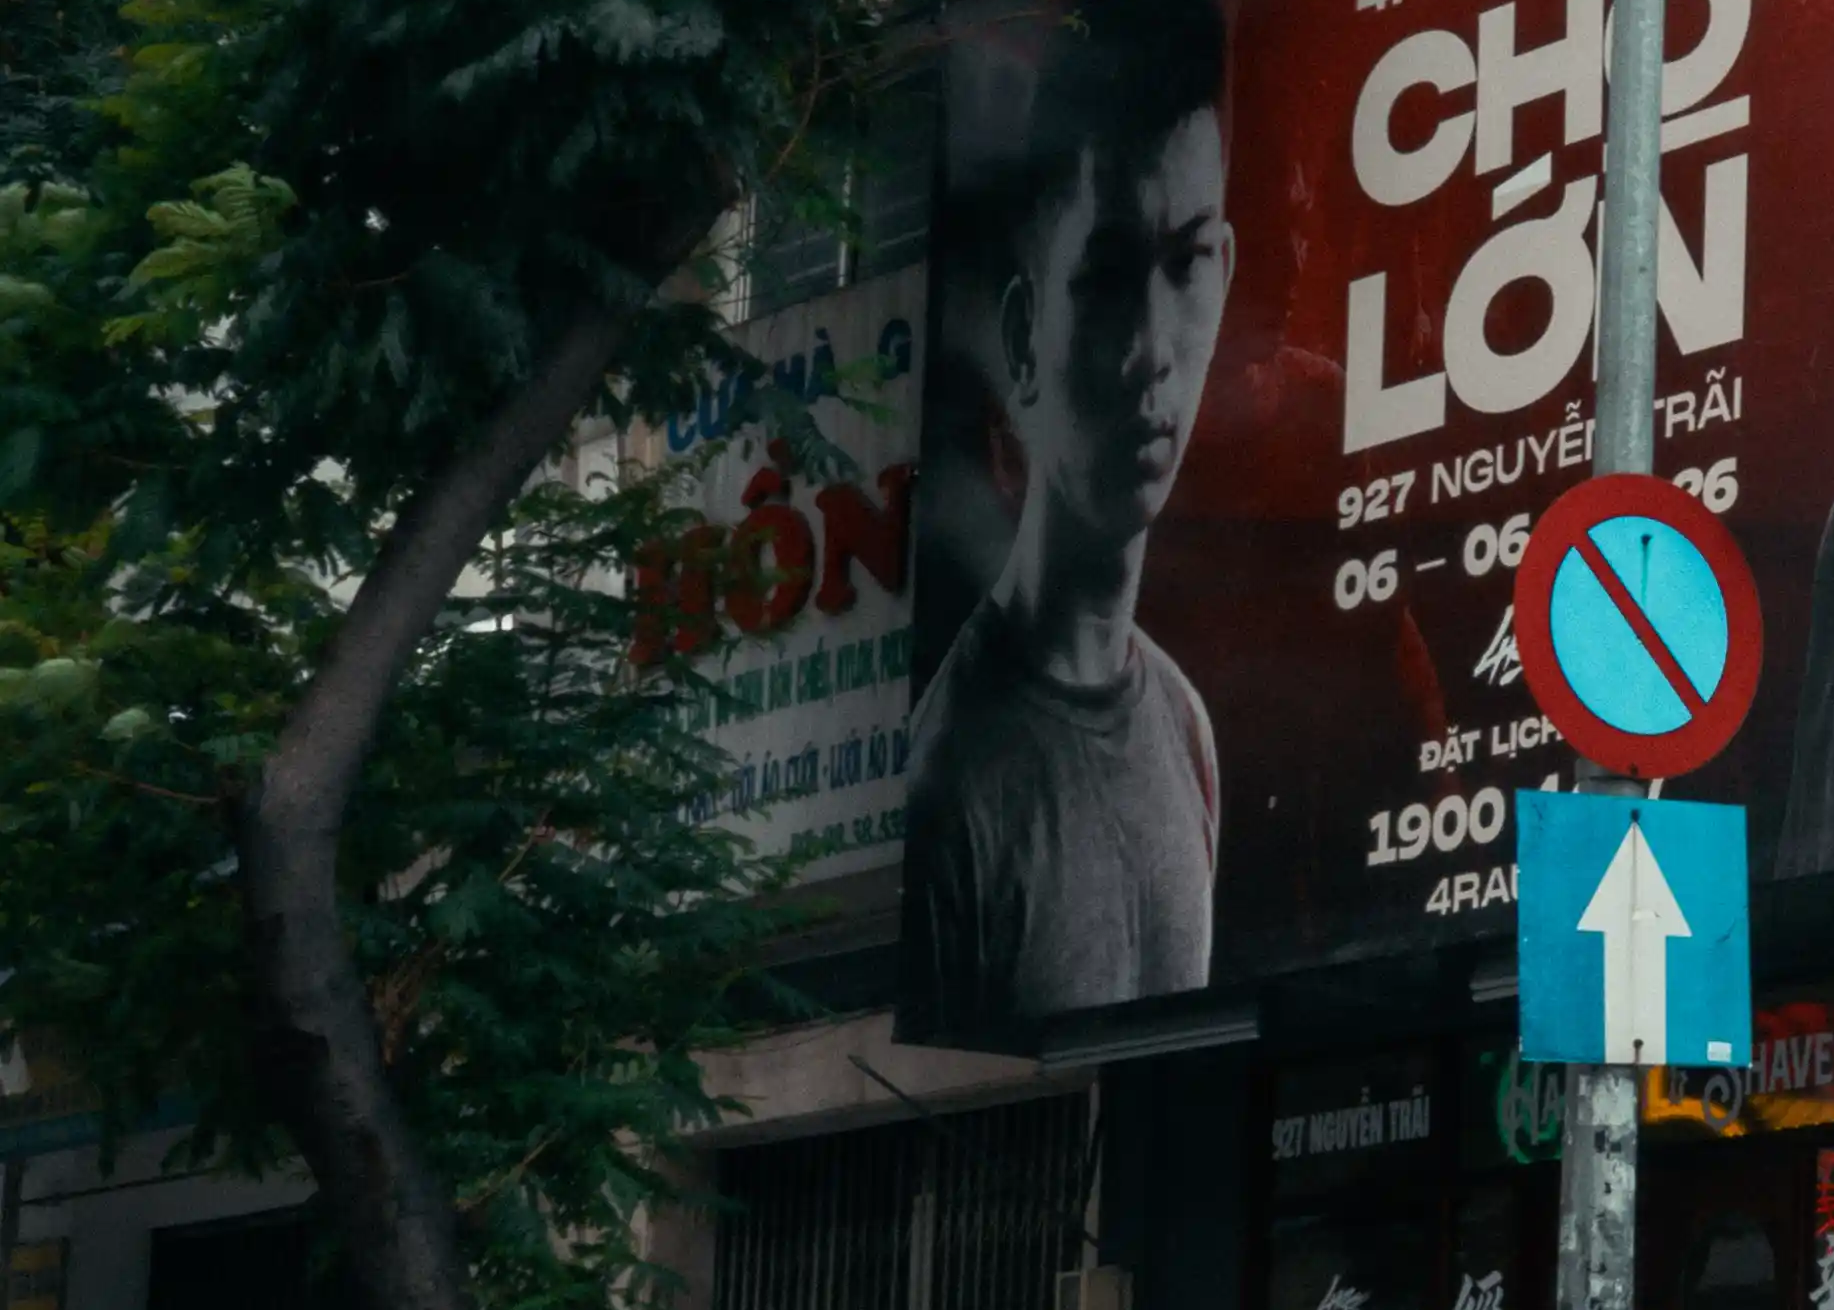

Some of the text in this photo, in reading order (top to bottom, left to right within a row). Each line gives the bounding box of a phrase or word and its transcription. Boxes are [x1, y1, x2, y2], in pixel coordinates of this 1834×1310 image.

[1342, 152, 1749, 456] LỚN
[1337, 470, 1416, 531] 927
[1431, 399, 1597, 504] NGUYỄ
[1654, 366, 1743, 440] RÃI
[1333, 549, 1399, 611] 06
[1463, 513, 1532, 577] 06
[1419, 725, 1481, 773] ĐẶT
[1367, 786, 1506, 868] 1900
[1271, 1114, 1306, 1161] 927
[1308, 1085, 1385, 1156] NGUYỄN
[1388, 1083, 1431, 1142] TRÃI
